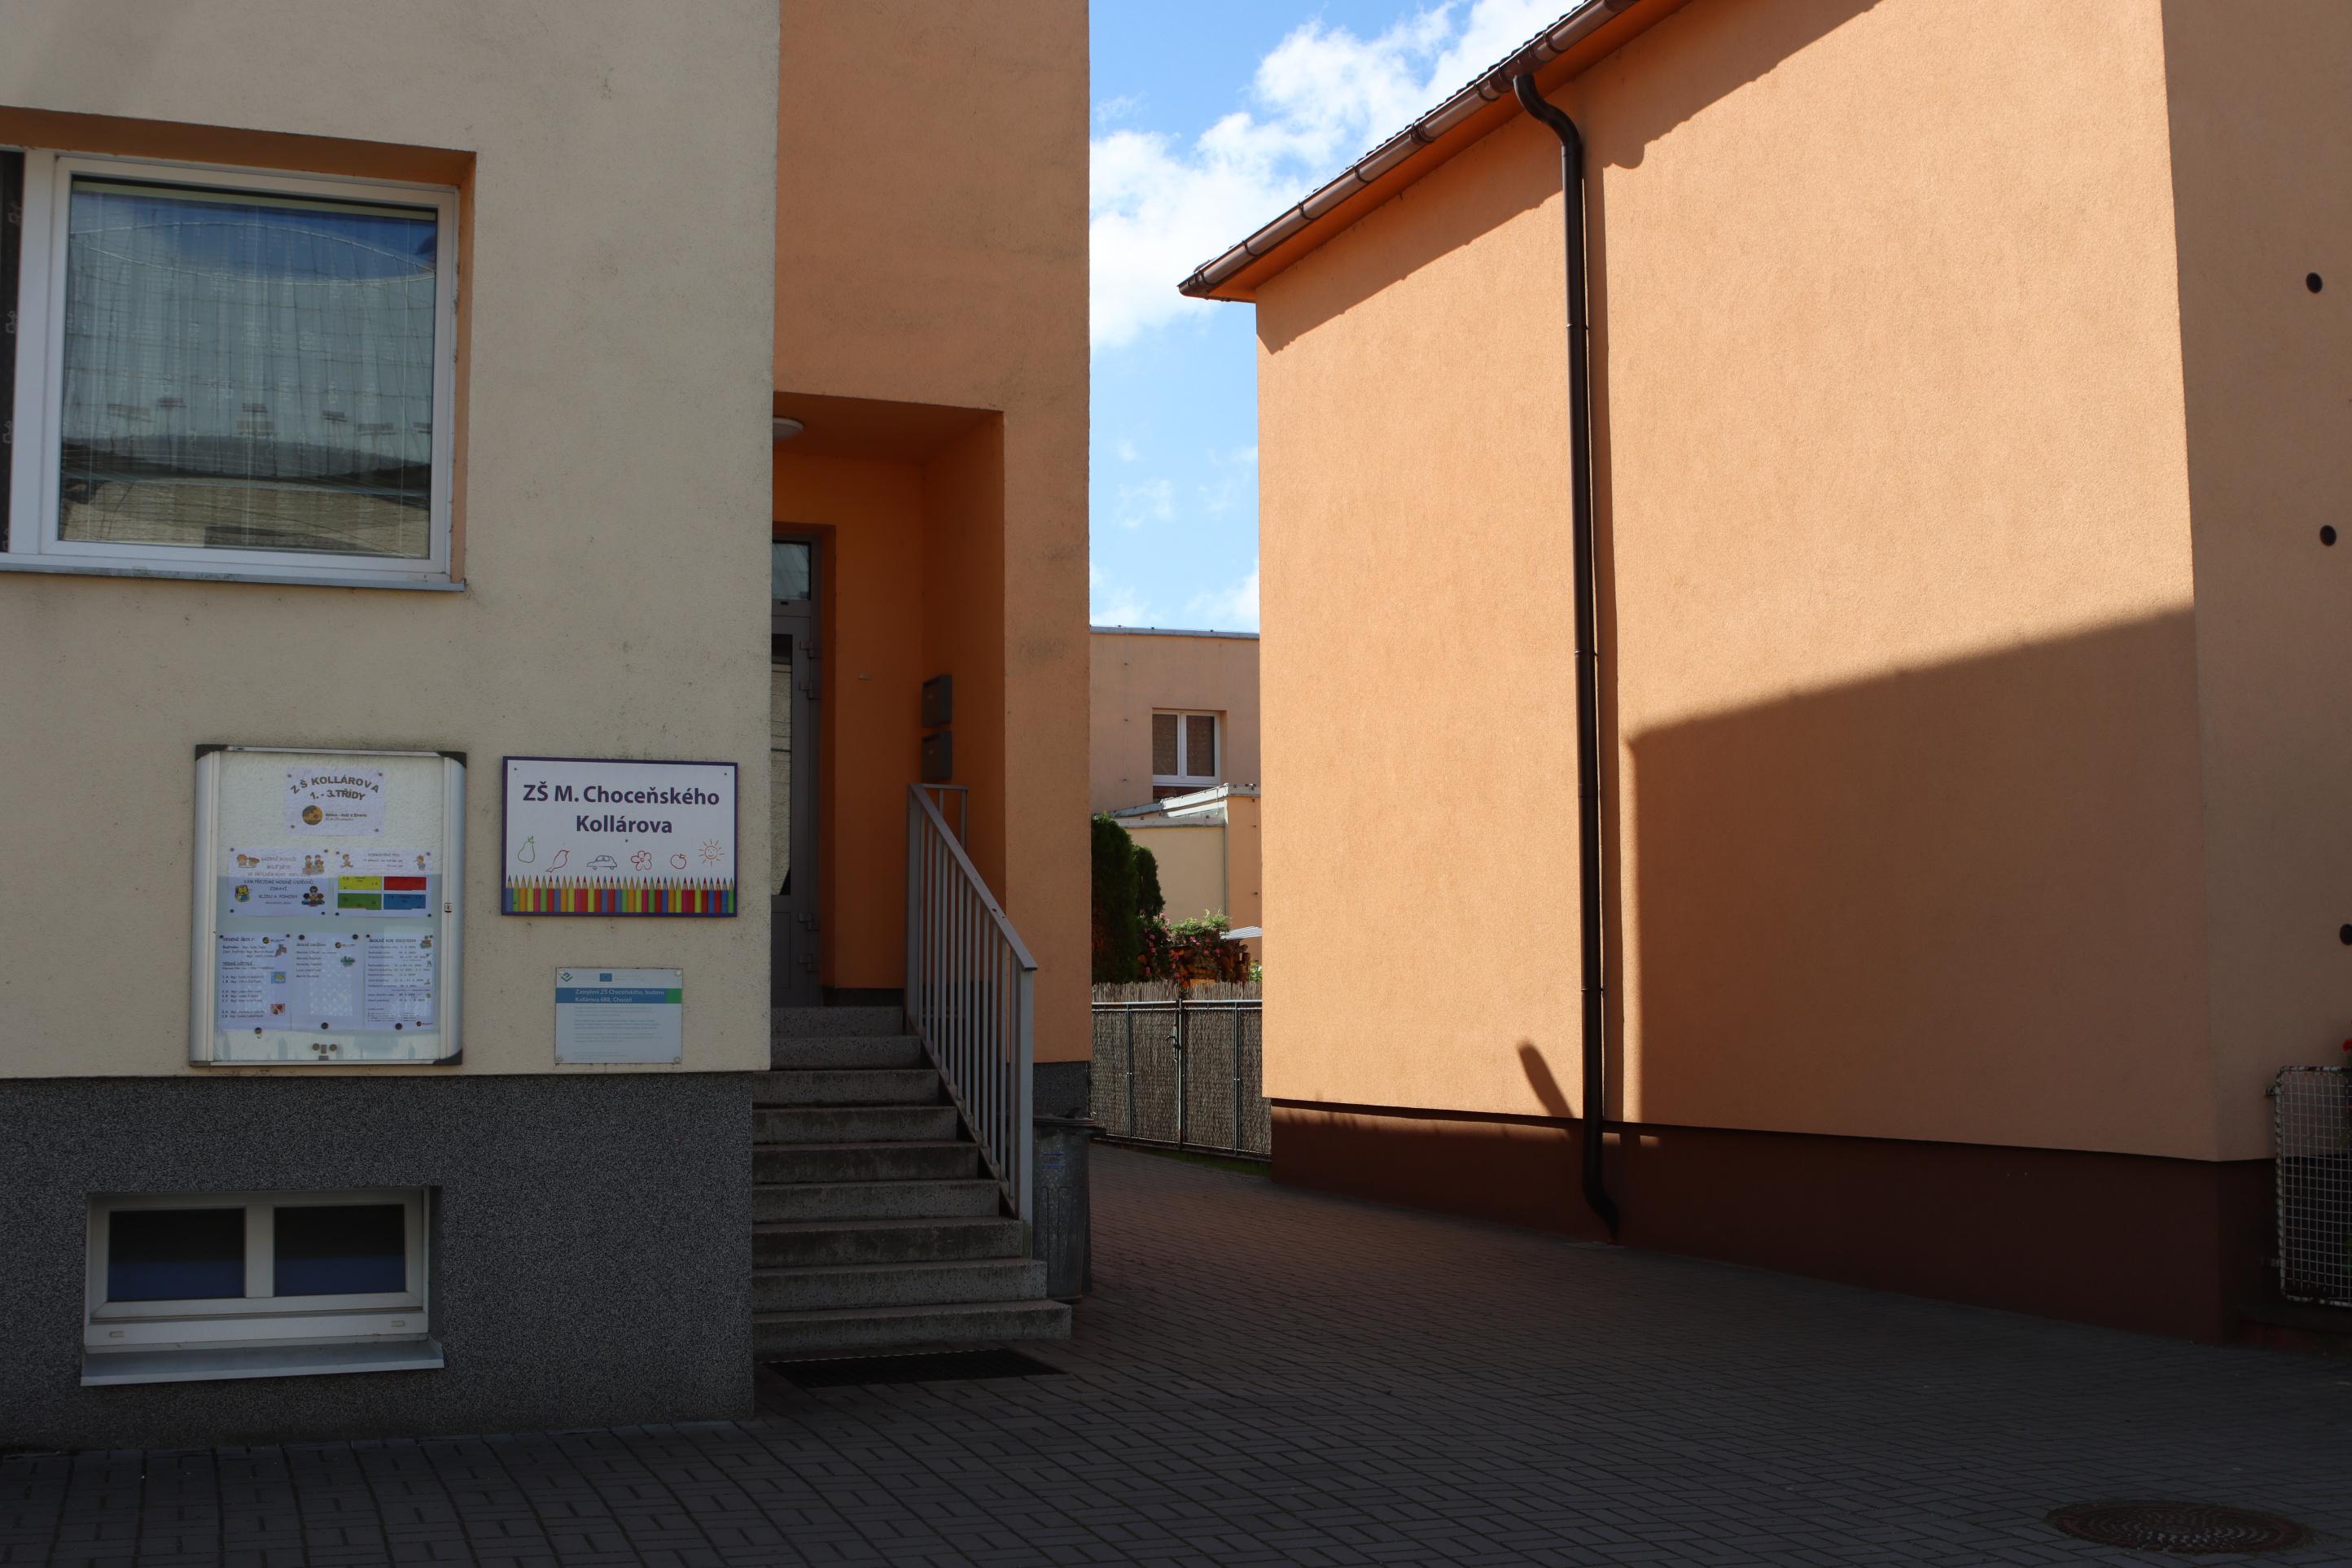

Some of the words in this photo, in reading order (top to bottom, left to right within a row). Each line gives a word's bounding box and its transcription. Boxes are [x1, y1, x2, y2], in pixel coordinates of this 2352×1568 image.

[311, 774, 380, 794] KOLLÁROVA
[523, 781, 549, 802] ZŠ
[554, 785, 580, 803] M.
[583, 786, 720, 805] Choceňského
[576, 814, 672, 834] Kollárova
